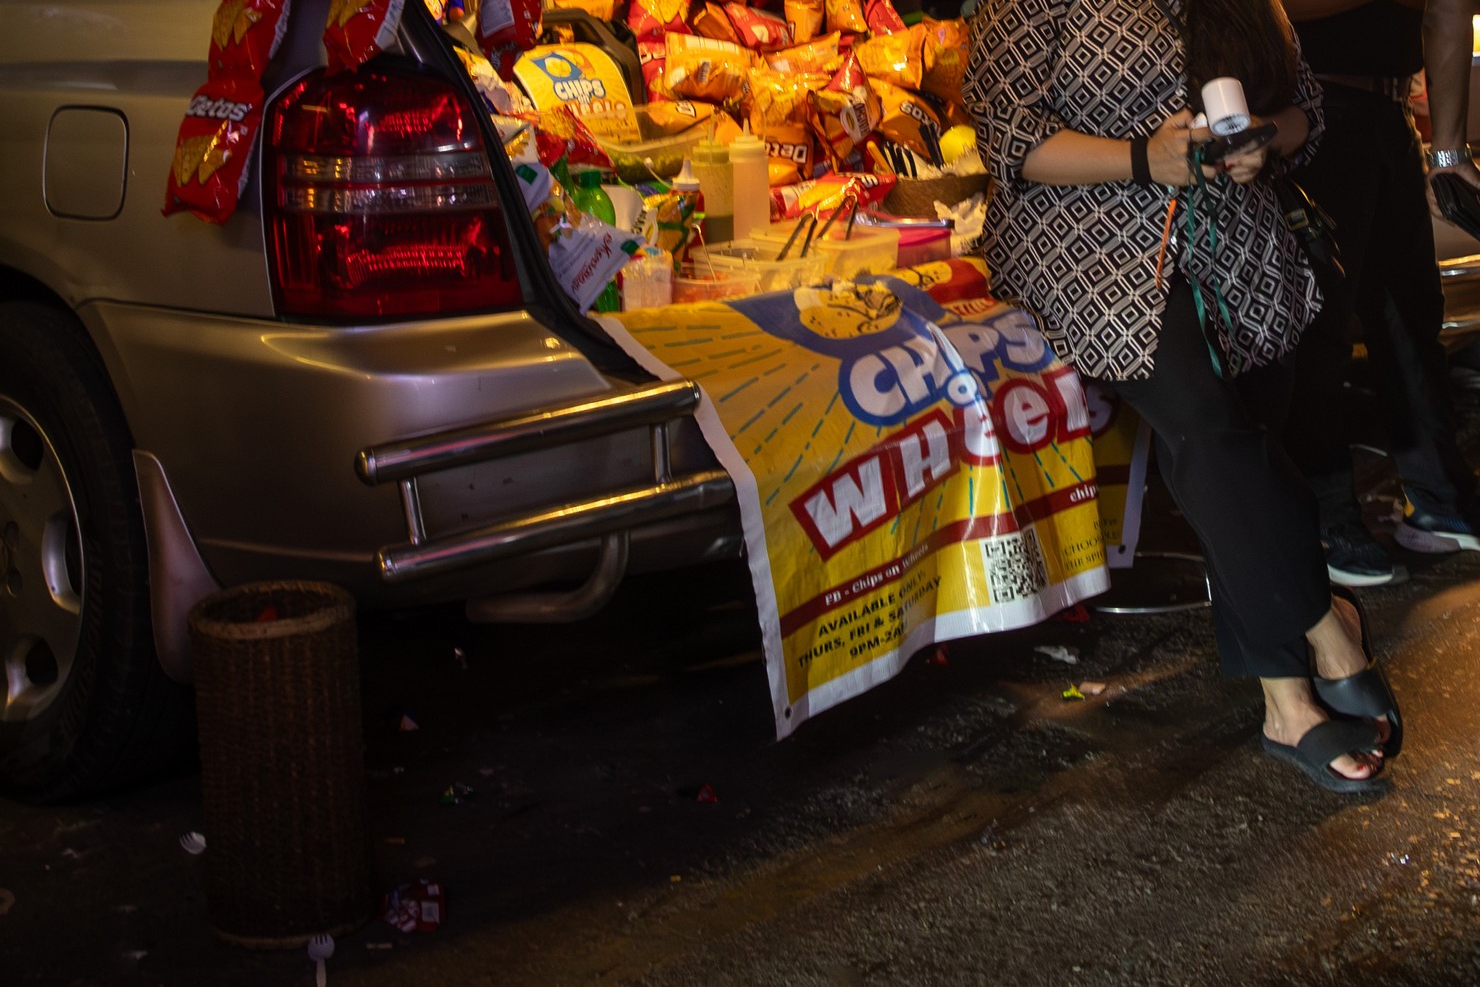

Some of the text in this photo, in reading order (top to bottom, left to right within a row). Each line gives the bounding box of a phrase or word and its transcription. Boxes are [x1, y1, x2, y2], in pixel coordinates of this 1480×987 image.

[554, 79, 605, 101] CHIPS
[845, 312, 1051, 420] CHIPS
[1069, 484, 1099, 503] chip
[825, 590, 842, 606] FB
[851, 571, 884, 594] Chips
[885, 564, 901, 579] on
[818, 592, 897, 638] AVAILABLE
[849, 622, 871, 641] FRI
[873, 617, 885, 629] &
[888, 576, 942, 621] SATURDAY
